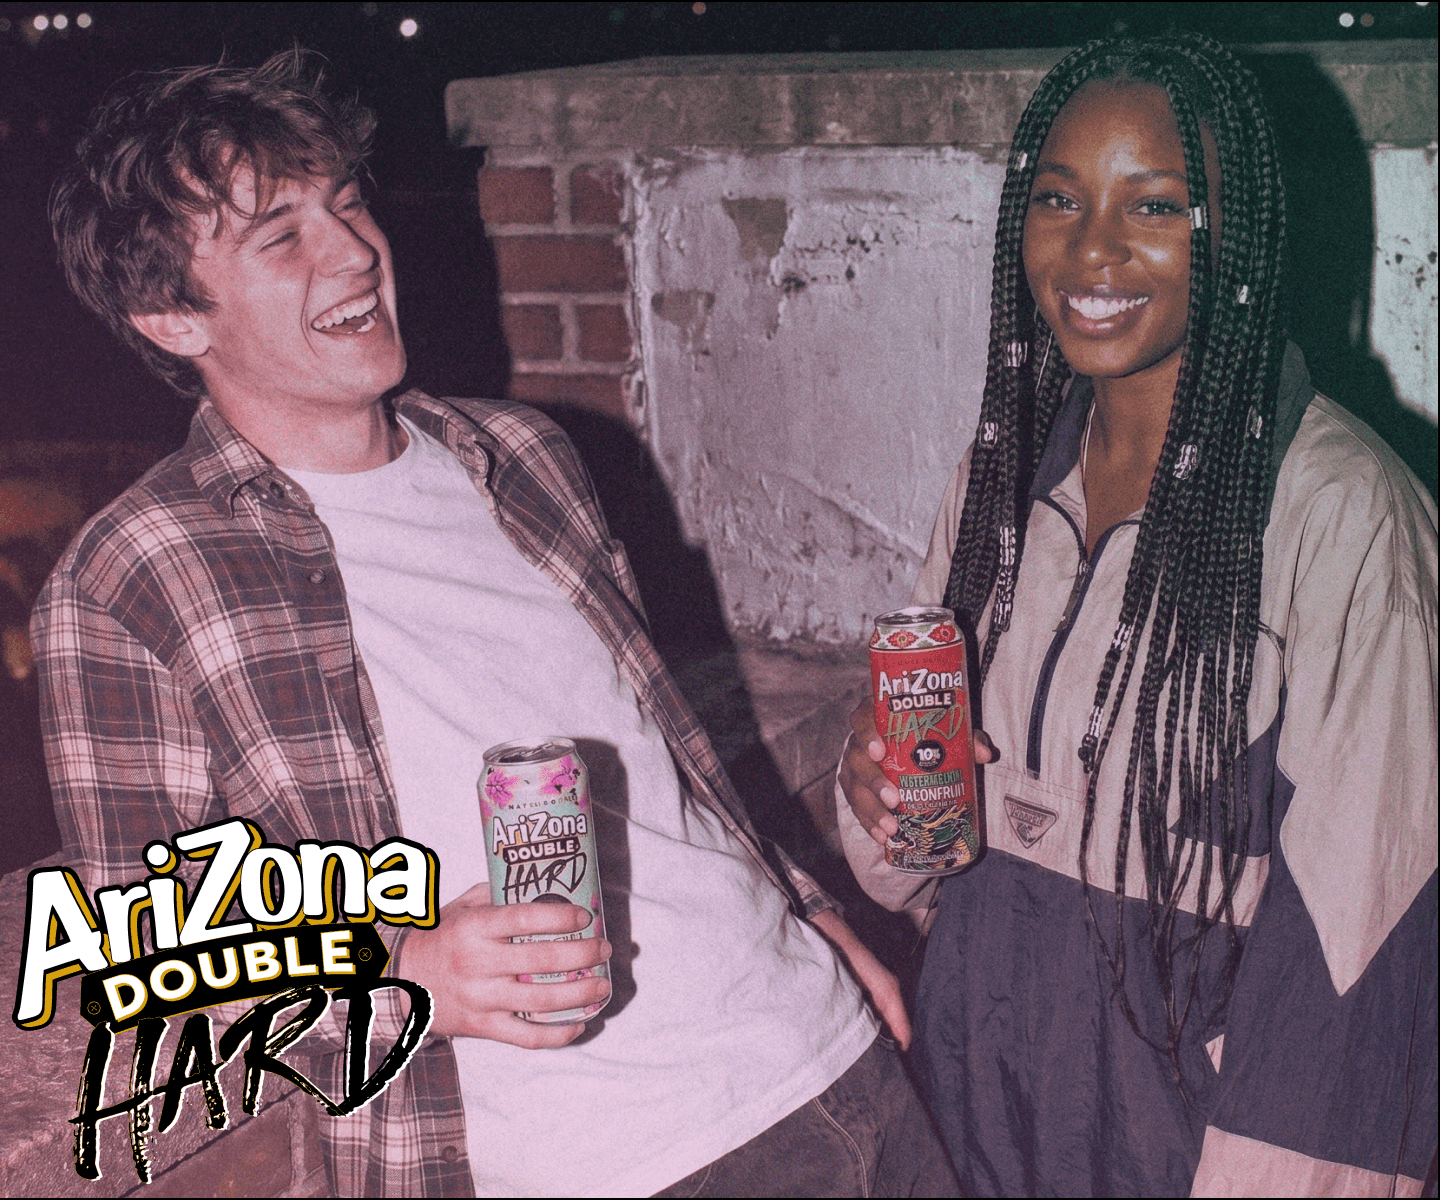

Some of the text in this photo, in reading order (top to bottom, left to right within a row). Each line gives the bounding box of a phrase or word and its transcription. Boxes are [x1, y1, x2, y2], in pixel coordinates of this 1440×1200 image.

[878, 667, 963, 702] AriZona
[891, 692, 951, 712] DOUBLE
[883, 704, 965, 752] HARD
[899, 782, 966, 802] RACONFRUIT
[492, 810, 588, 855] AriZona
[507, 839, 576, 863] DOUBLE
[502, 851, 587, 905] HARD
